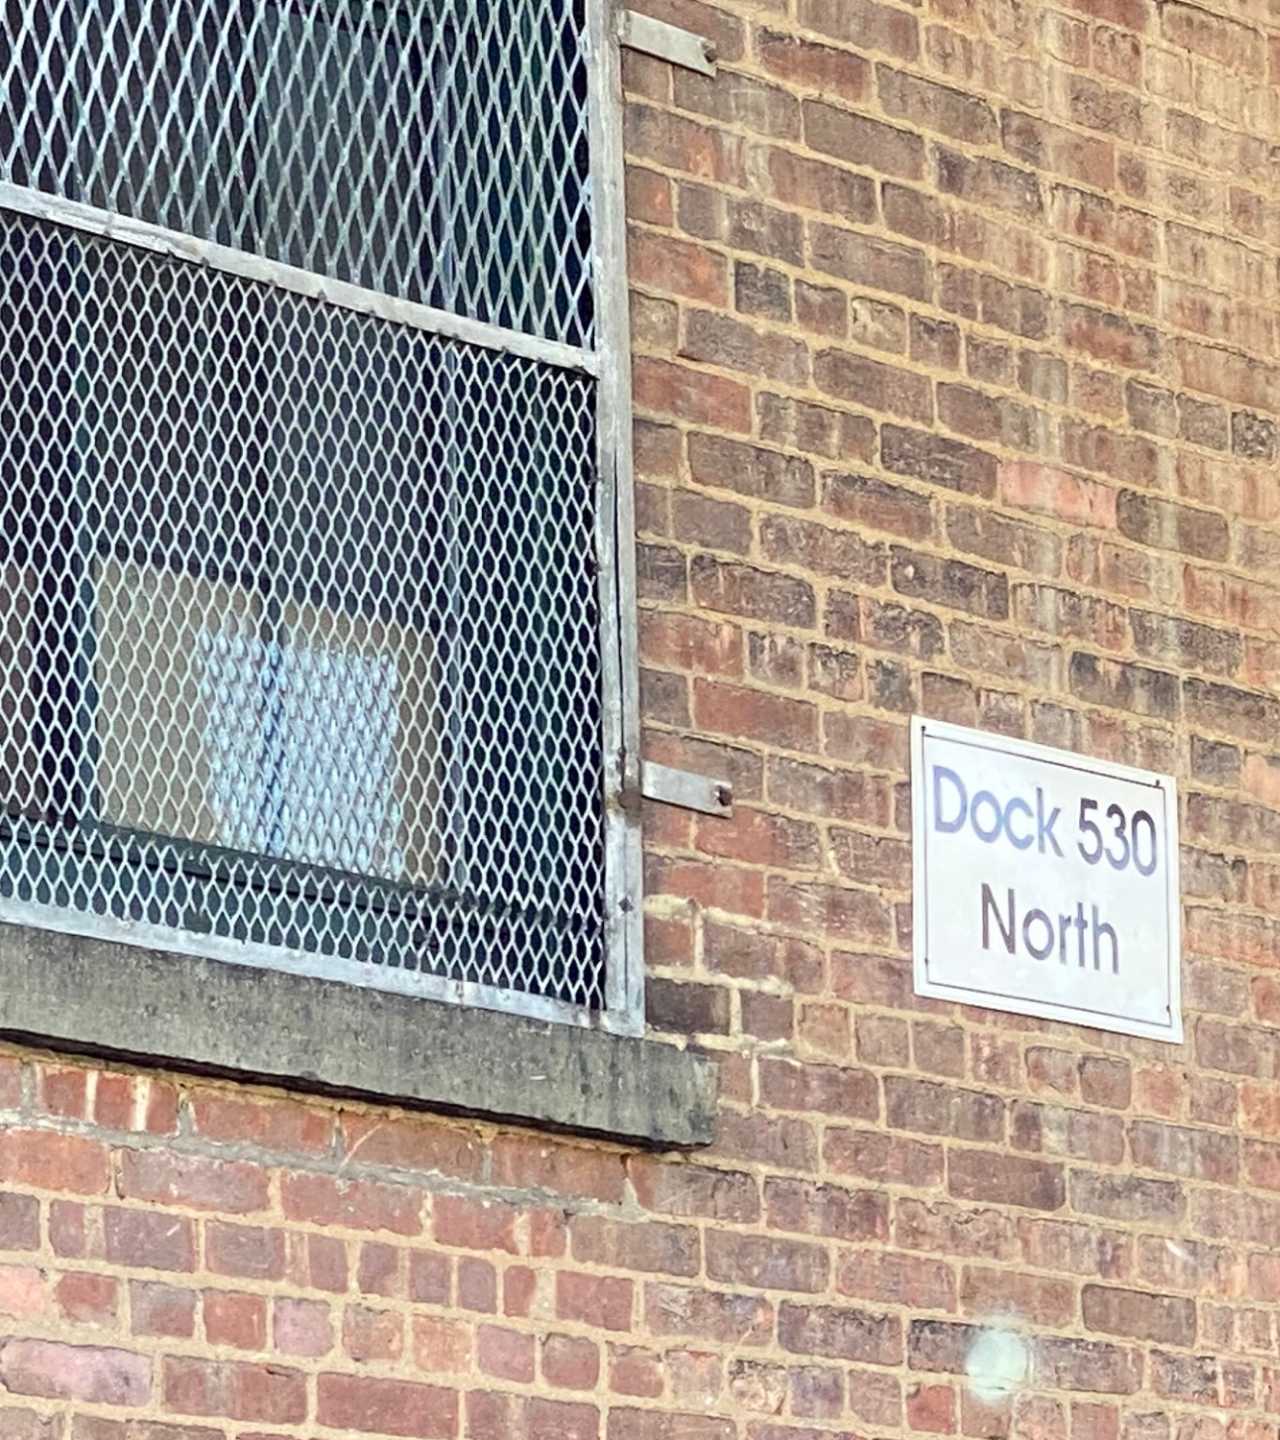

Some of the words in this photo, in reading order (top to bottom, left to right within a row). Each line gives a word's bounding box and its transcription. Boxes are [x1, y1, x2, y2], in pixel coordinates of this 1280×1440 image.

[932, 764, 1065, 858] Dock
[1077, 797, 1158, 877] 530
[980, 882, 1119, 975] North
